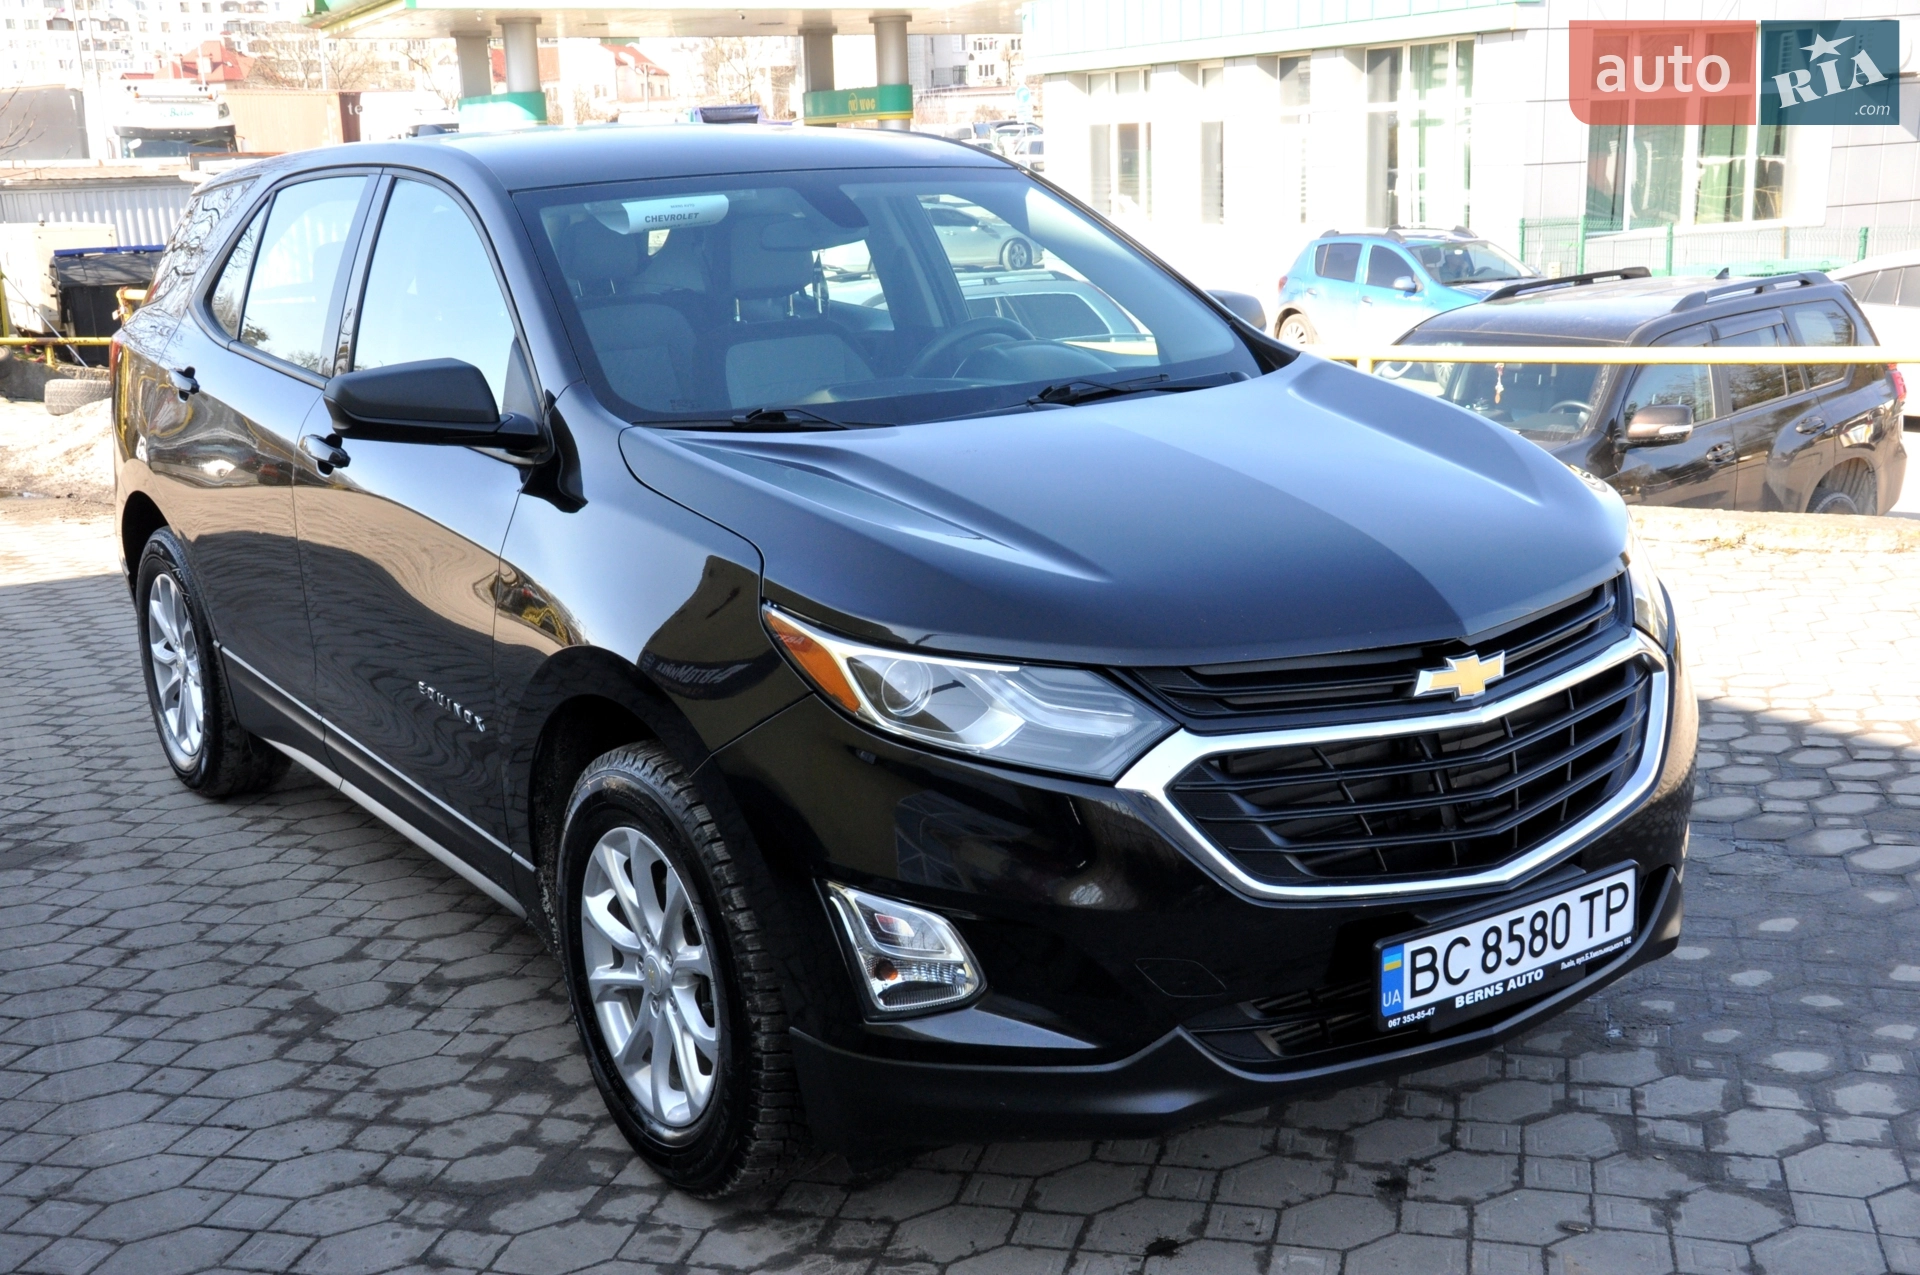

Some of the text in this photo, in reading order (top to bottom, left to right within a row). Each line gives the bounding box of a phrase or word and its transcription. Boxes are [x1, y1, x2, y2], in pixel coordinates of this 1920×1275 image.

[644, 212, 699, 223] CHEVROLET
[418, 680, 486, 733] EQUINOX
[1410, 882, 1630, 999] BC 8580 TP
[1383, 991, 1402, 1007] UA
[1455, 968, 1544, 1009] BERNS AUTO
[1388, 1007, 1436, 1028] 067 353-85-47
